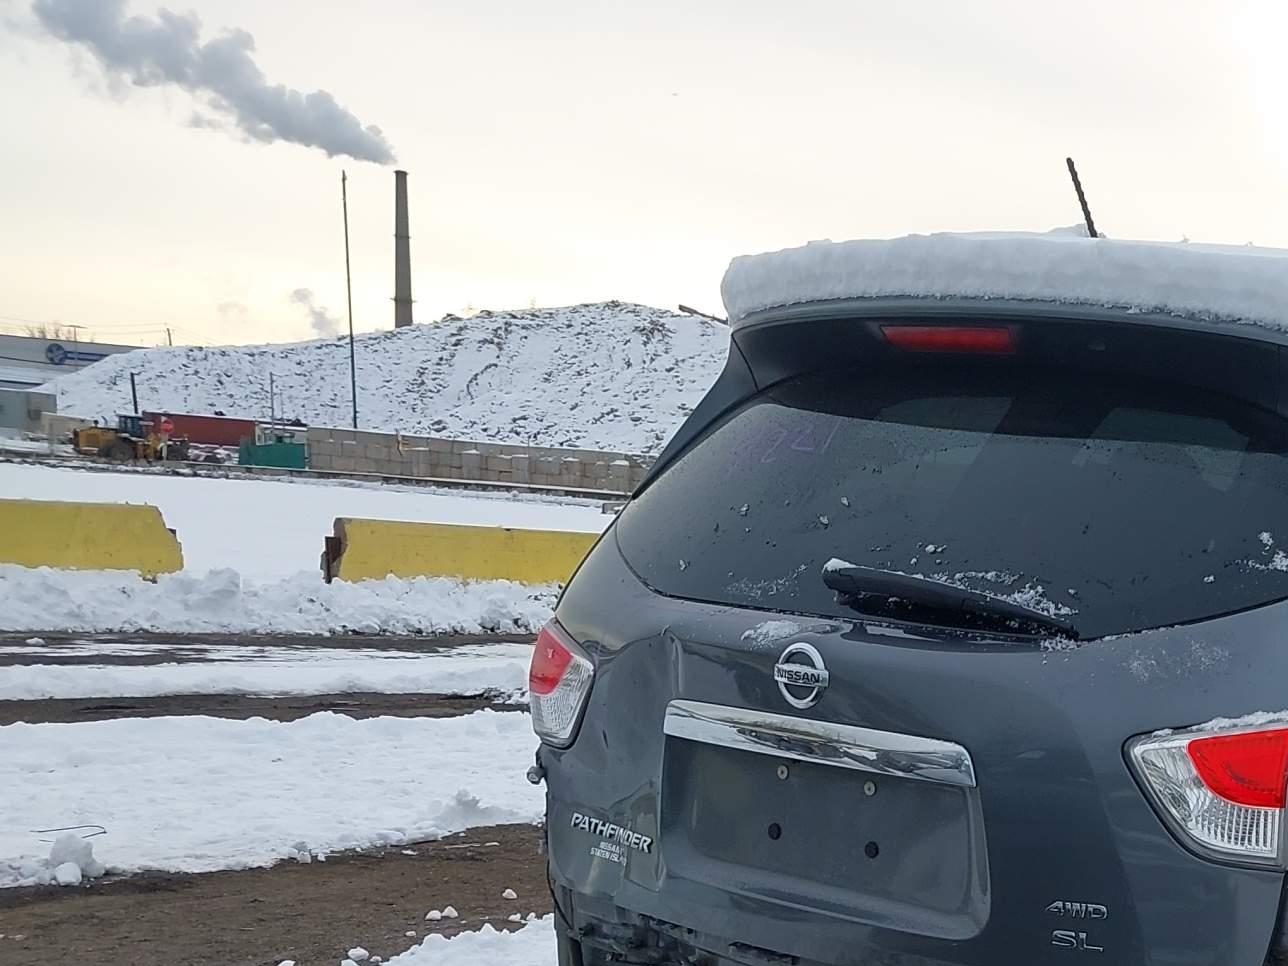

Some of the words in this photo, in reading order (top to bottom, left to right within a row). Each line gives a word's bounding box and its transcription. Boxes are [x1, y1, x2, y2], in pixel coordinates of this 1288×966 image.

[777, 668, 821, 684] NISSAN
[570, 812, 653, 853] PATHFINDER
[1045, 901, 1108, 919] 4WD
[1051, 930, 1104, 952] SL
